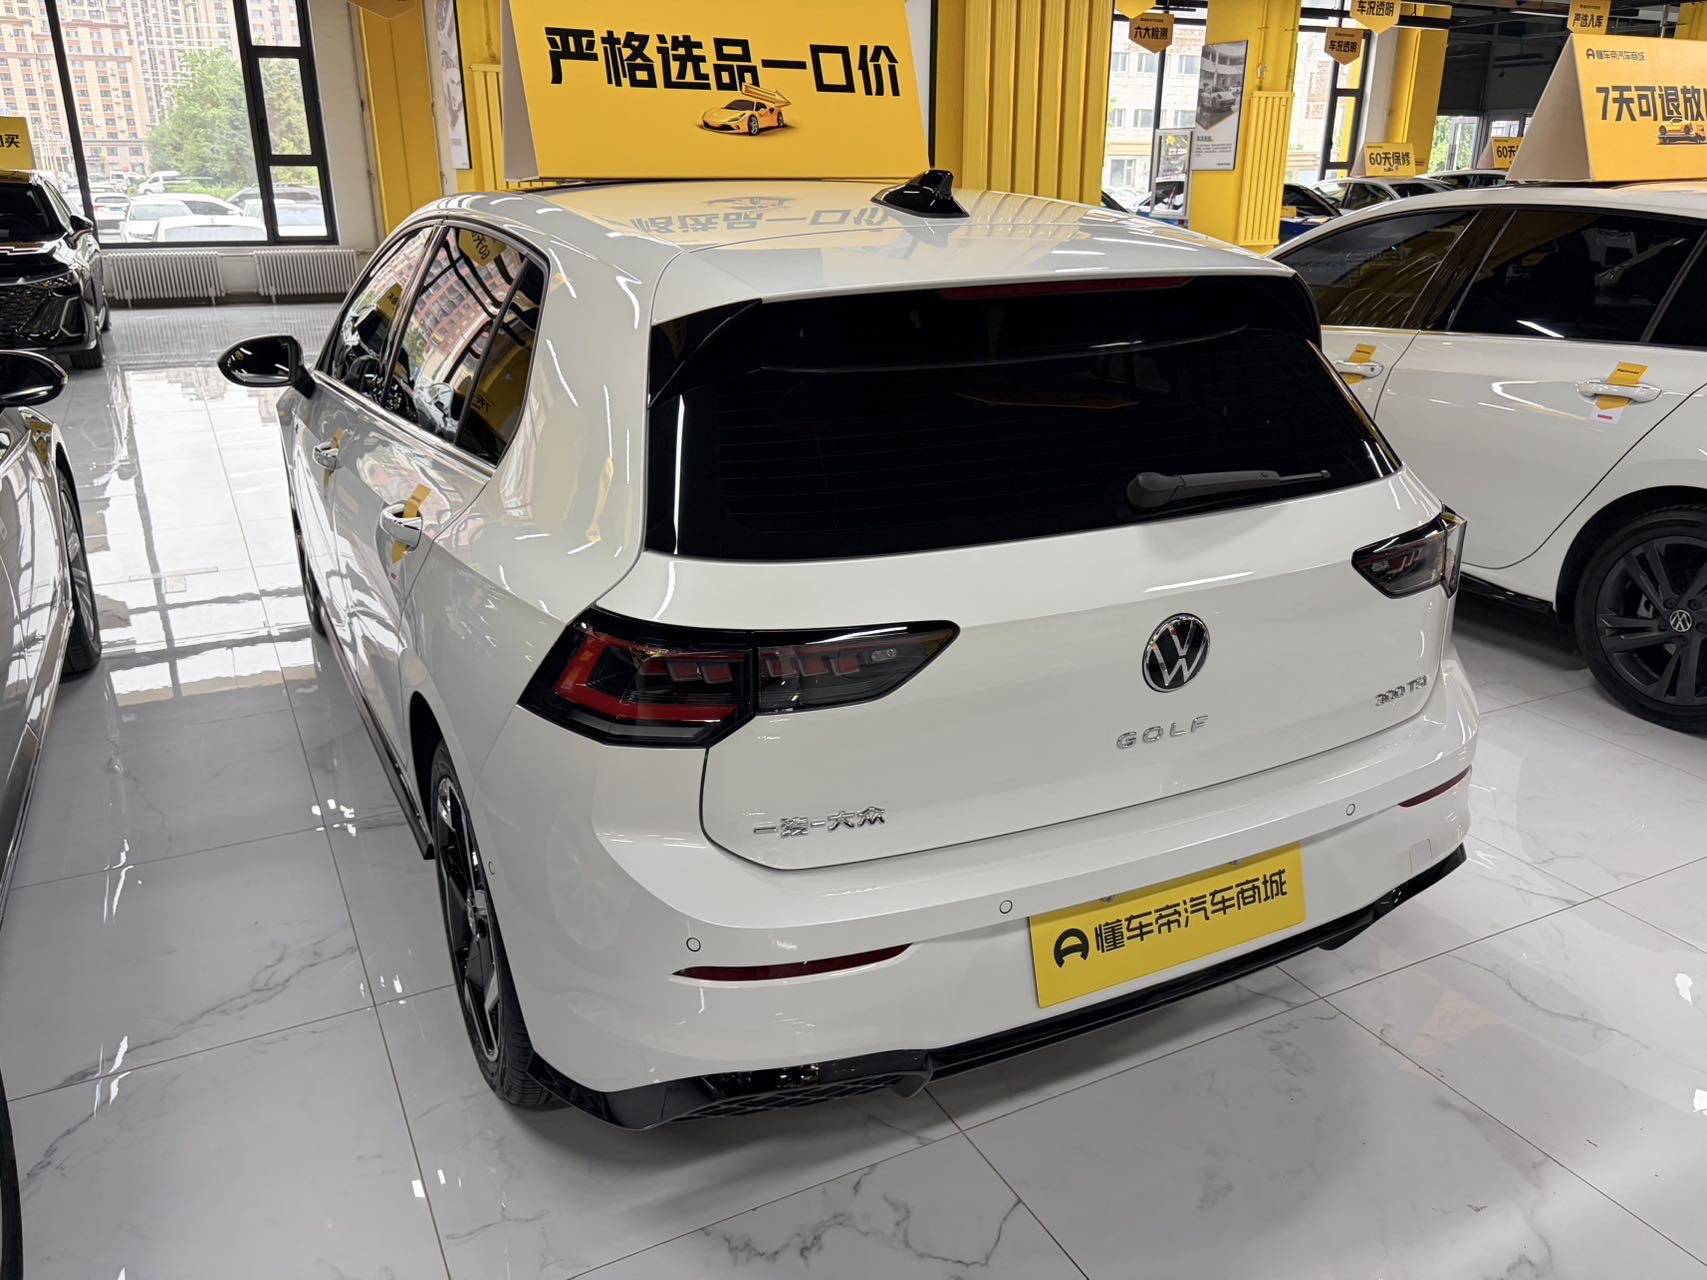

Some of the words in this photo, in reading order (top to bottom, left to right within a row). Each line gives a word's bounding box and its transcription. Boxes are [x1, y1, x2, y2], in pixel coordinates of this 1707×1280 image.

[1357, 0, 1395, 16] 车况透明
[1572, 13, 1604, 28] 严选入库
[1134, 25, 1169, 40] 六大检测
[1328, 39, 1358, 53] 车况透明
[544, 26, 901, 97] 严格选品一口价
[1596, 85, 1707, 122] 7天可退放
[1368, 151, 1412, 167] 60天保修
[1496, 145, 1520, 159] 60天
[1115, 715, 1209, 750] GOLF
[1094, 868, 1288, 954] 懂车帝汽车商城
